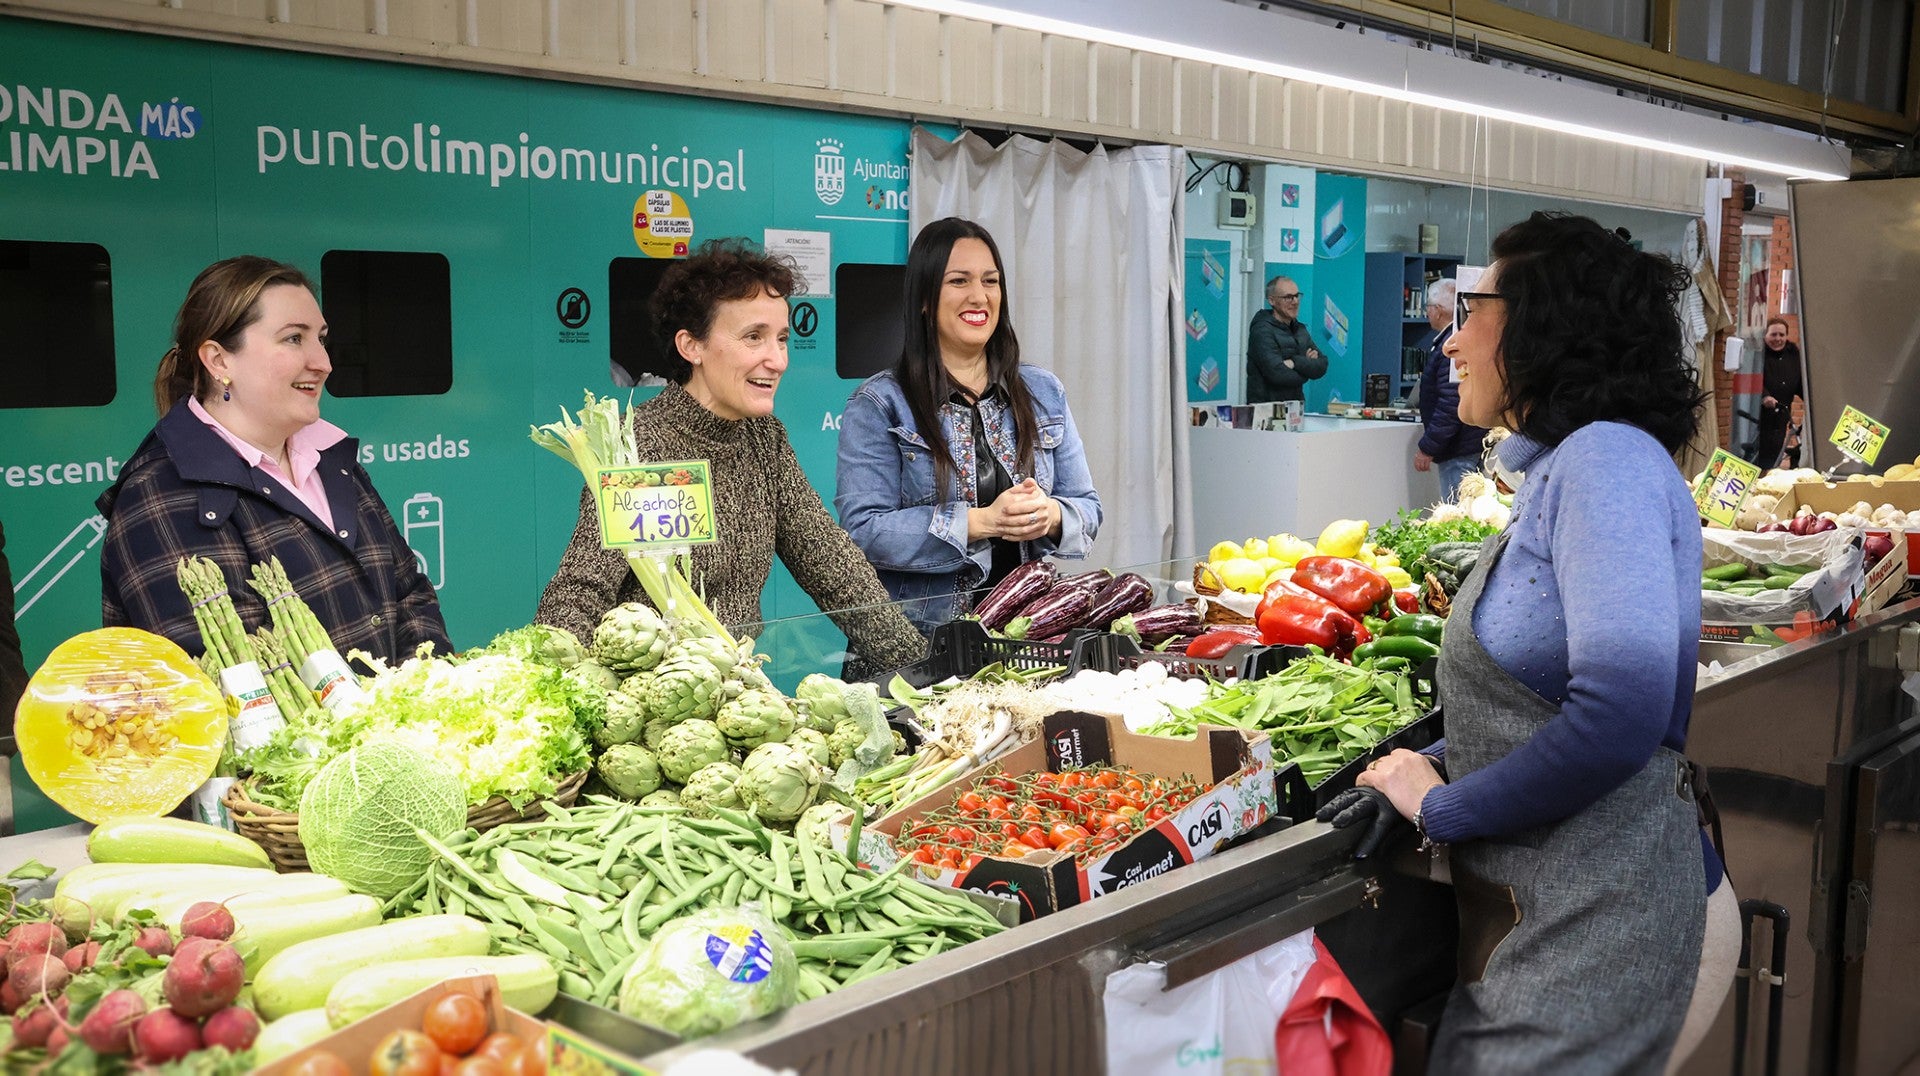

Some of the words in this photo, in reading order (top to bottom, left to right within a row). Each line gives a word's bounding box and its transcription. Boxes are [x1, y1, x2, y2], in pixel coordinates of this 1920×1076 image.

[140, 96, 196, 139] MÁS
[256, 122, 746, 197] puntolimpiomunicipal
[383, 434, 470, 462] usadas
[0, 456, 127, 487] escent
[612, 489, 697, 515] Alcachofa
[1071, 728, 1083, 768] Gourmet
[1188, 809, 1223, 848] CASI
[1125, 862, 1142, 880] Casi
